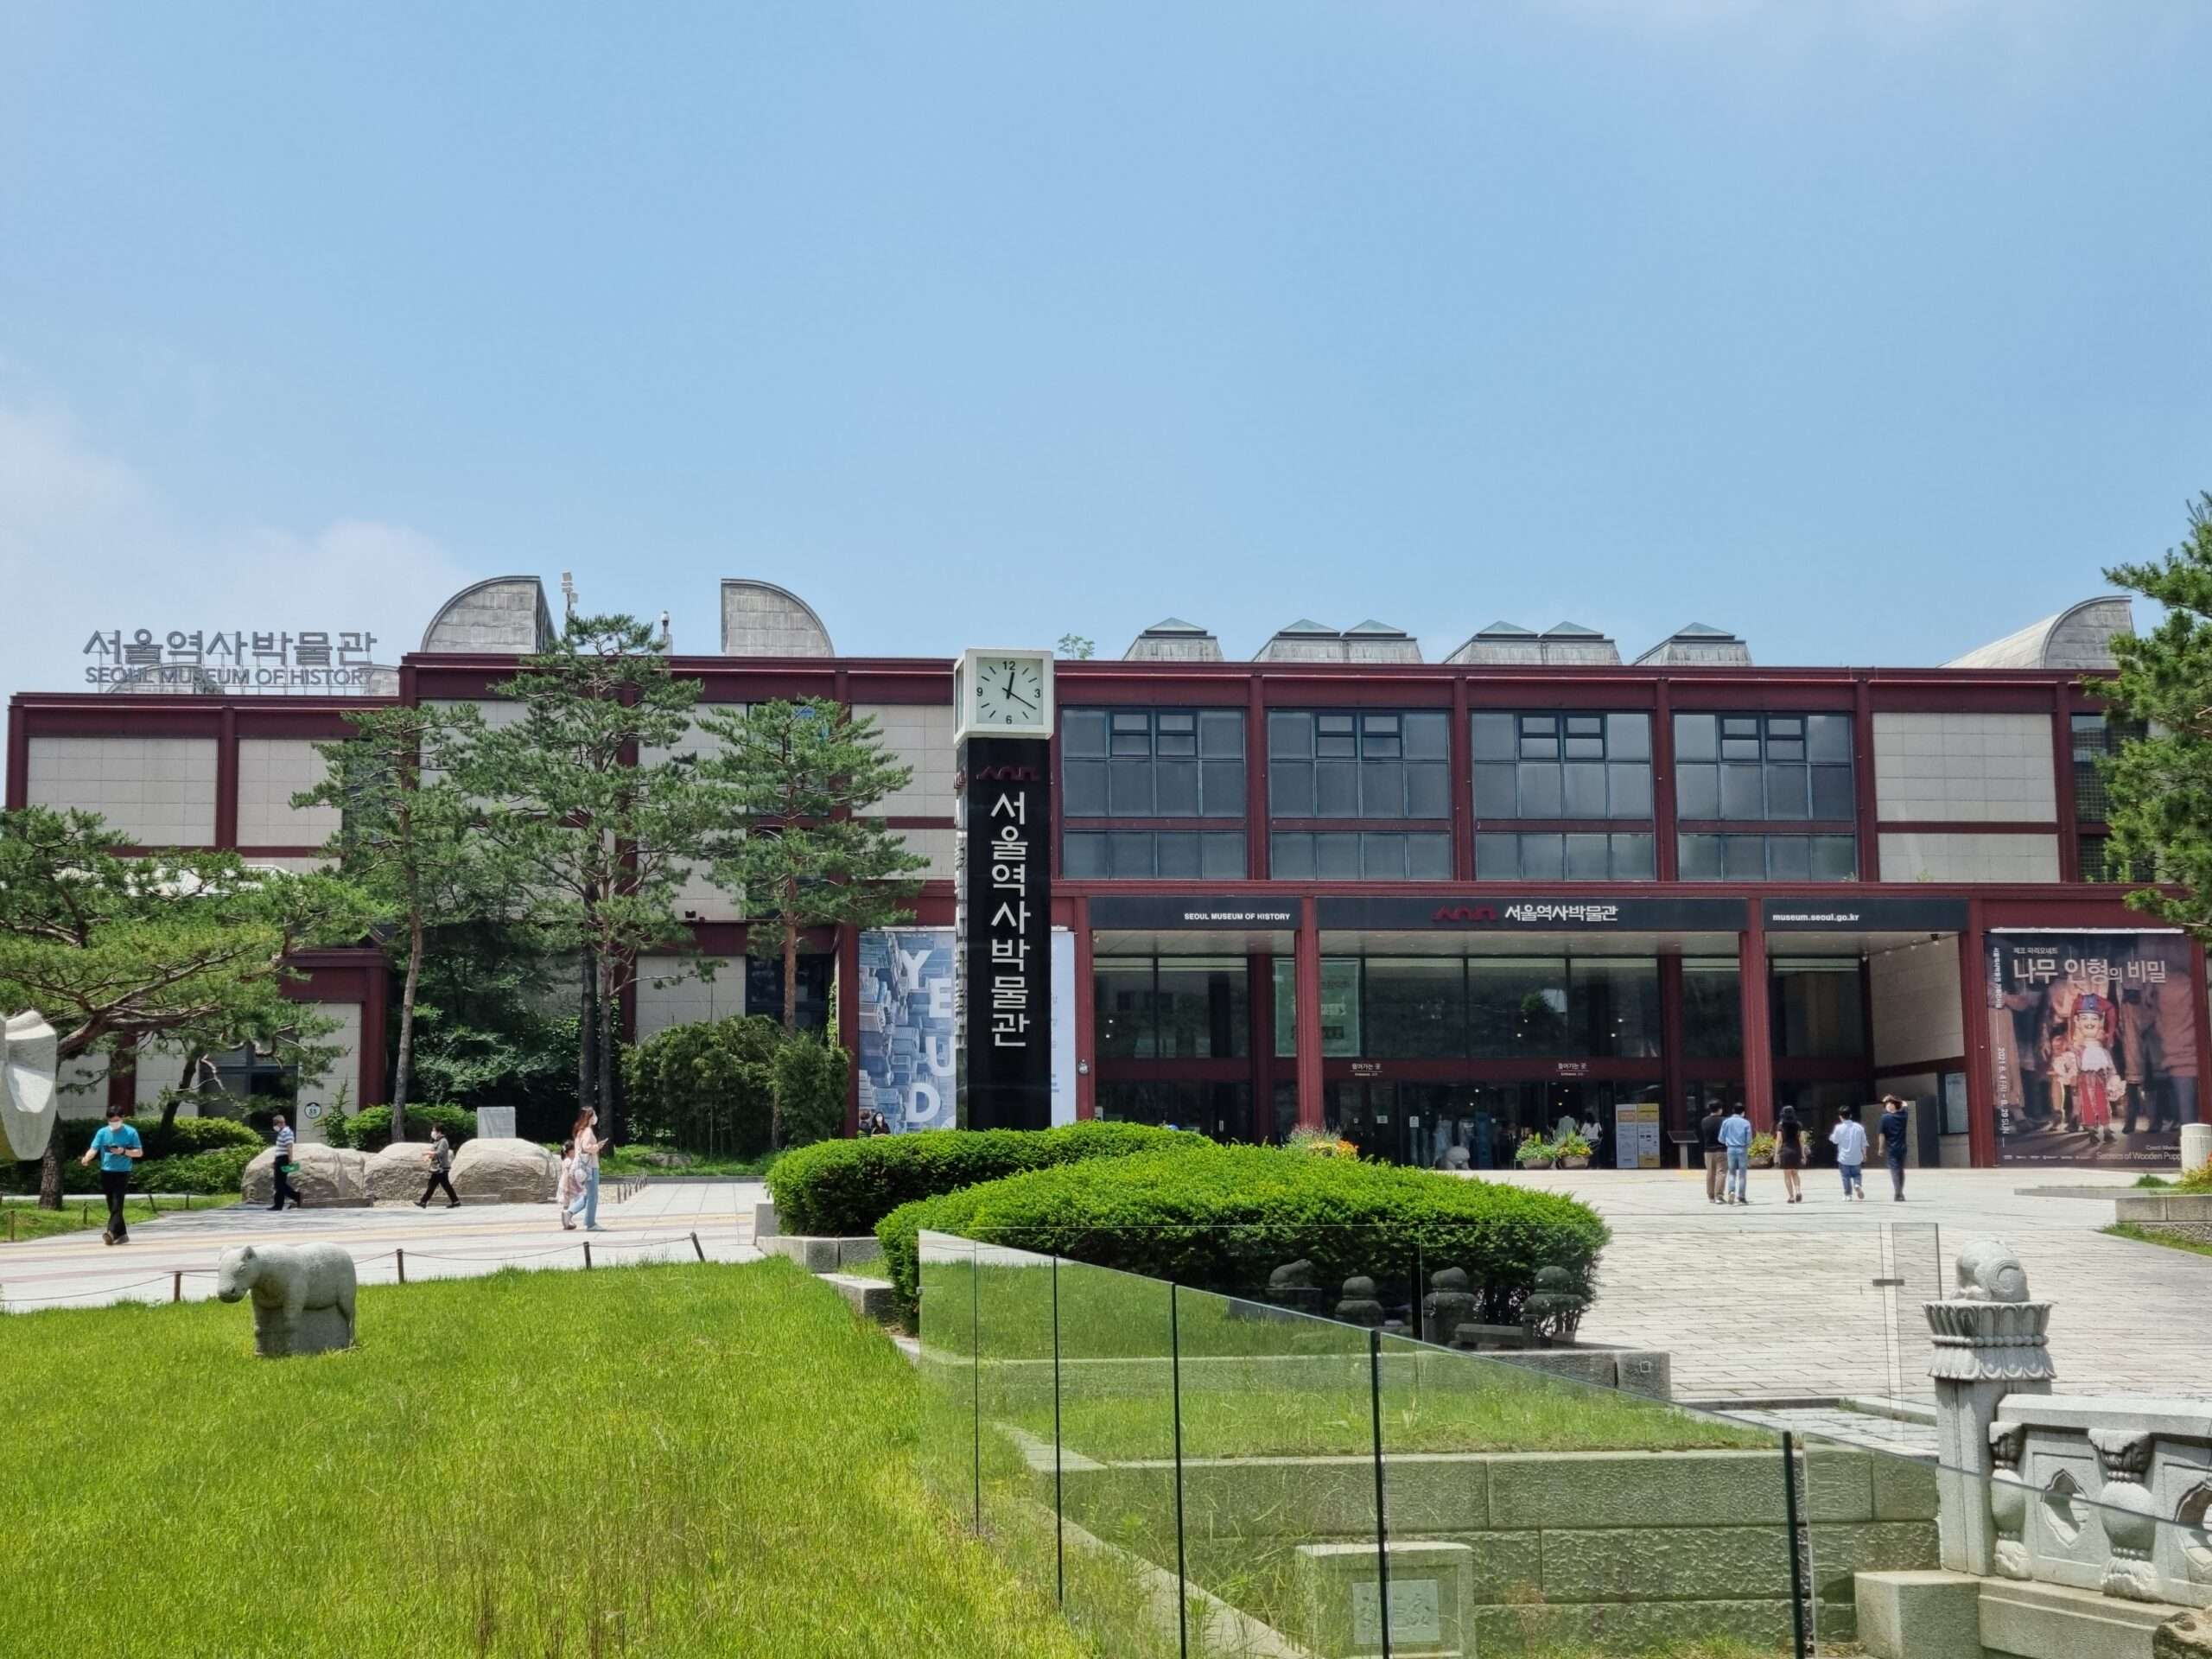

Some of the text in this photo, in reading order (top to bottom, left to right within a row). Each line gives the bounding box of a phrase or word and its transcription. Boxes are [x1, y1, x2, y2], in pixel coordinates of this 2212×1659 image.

[83, 628, 378, 665] 서울역사박물관
[1002, 661, 1016, 671] 12
[85, 666, 374, 685] SEOUL MUSEUM OF HISTORY
[976, 687, 983, 696] 9
[1033, 689, 1041, 699] 3
[1005, 715, 1013, 725] 6
[990, 791, 1032, 1047] 서울역사박물관
[1504, 904, 1618, 922] 서울역사박물관
[1772, 912, 1860, 922] museum.seoul.go.kr
[2013, 958, 2167, 985] 나무 인형의 비밀
